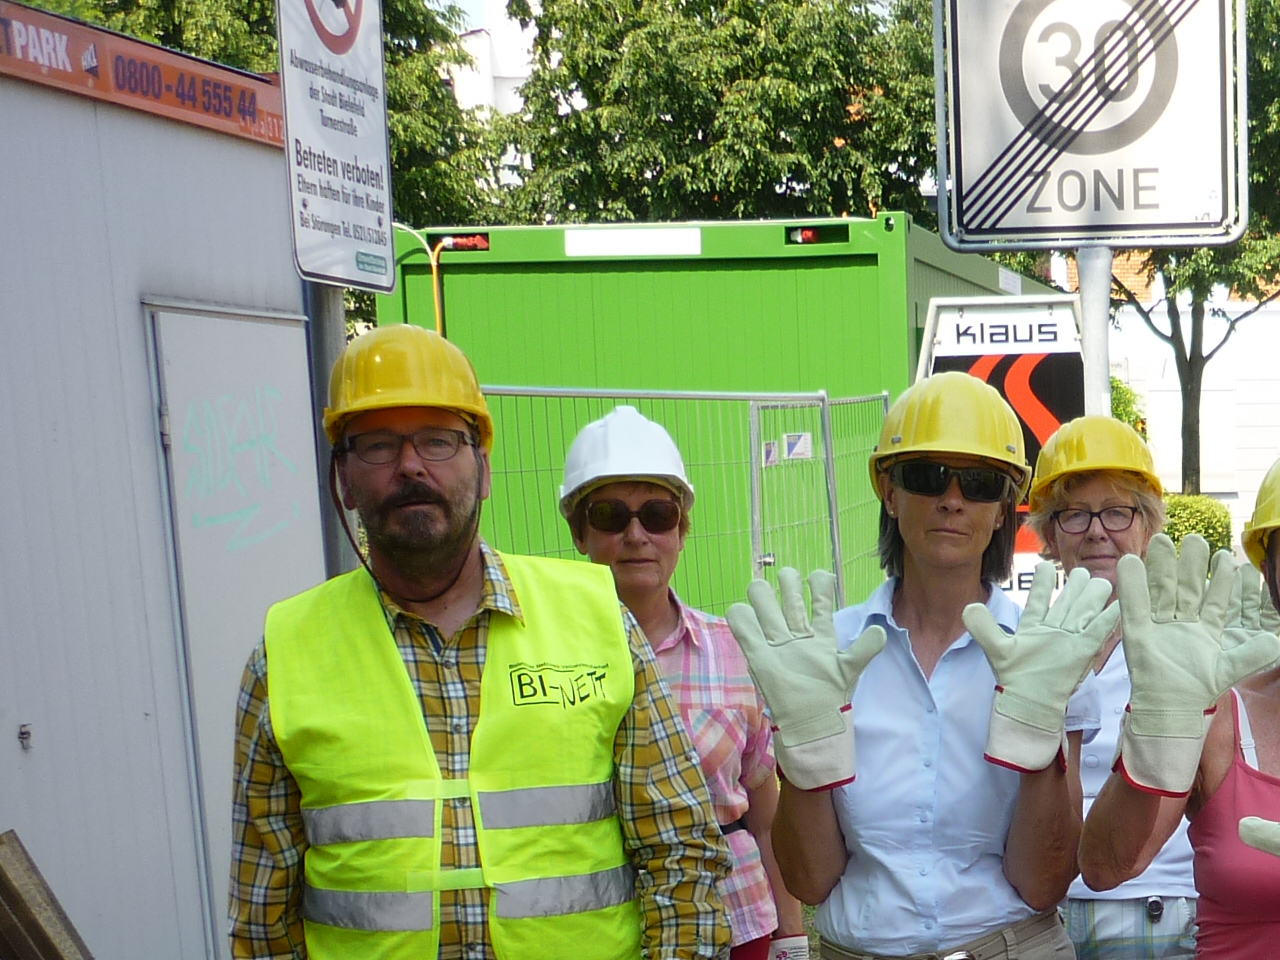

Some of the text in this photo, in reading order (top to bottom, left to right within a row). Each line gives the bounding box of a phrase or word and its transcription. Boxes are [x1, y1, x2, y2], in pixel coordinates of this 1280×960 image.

[0, 17, 72, 73] TPARK
[1037, 20, 1138, 103] 30
[202, 79, 233, 117] 555
[237, 89, 257, 123] 44
[309, 81, 365, 117] der Stadt Bielefeld
[295, 138, 385, 191] Betreten verboten!
[297, 173, 385, 214] Eltern haften für ihre Kinder
[1026, 168, 1160, 214] ZONE
[300, 210, 311, 229] Bei
[311, 214, 341, 239] Störungen
